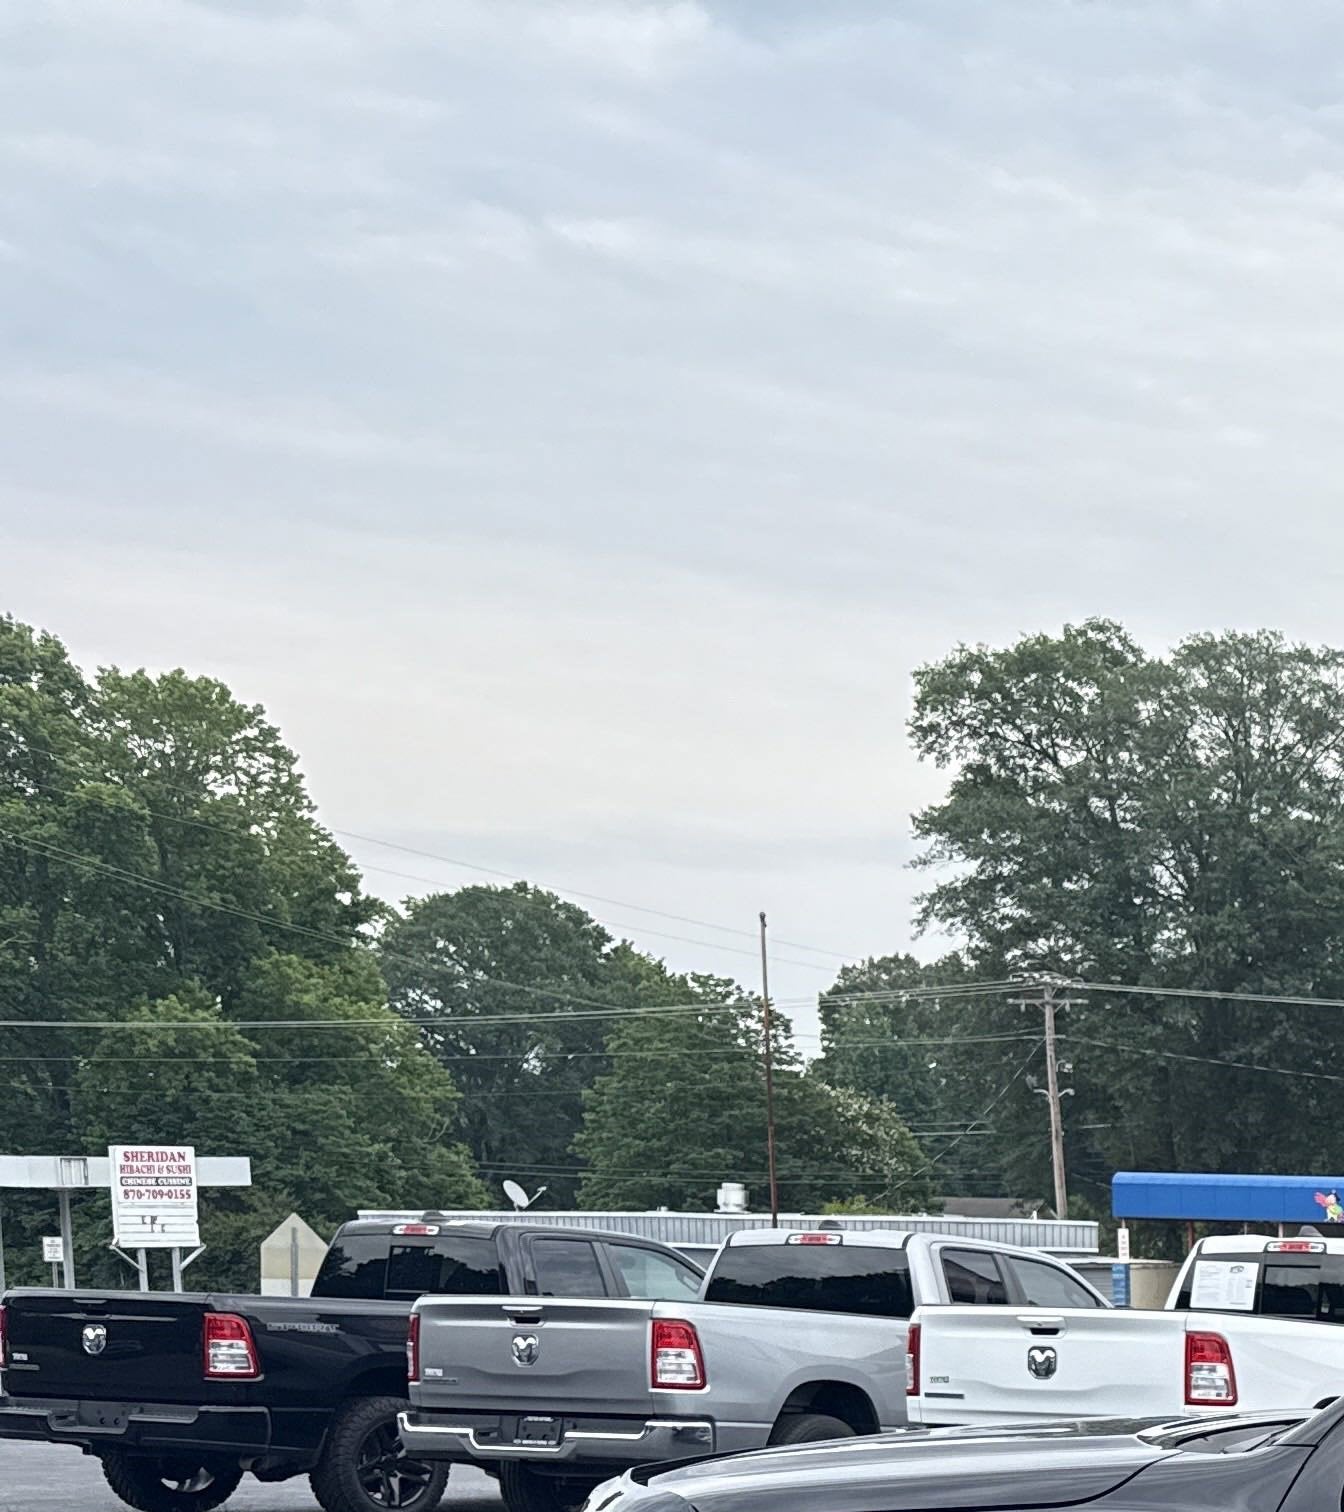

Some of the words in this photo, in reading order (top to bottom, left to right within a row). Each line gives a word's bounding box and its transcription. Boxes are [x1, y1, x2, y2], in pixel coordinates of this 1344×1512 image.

[123, 1150, 186, 1162] SHERIDAN
[119, 1164, 156, 1174] HIBACHI
[166, 1164, 192, 1174] SUSHI
